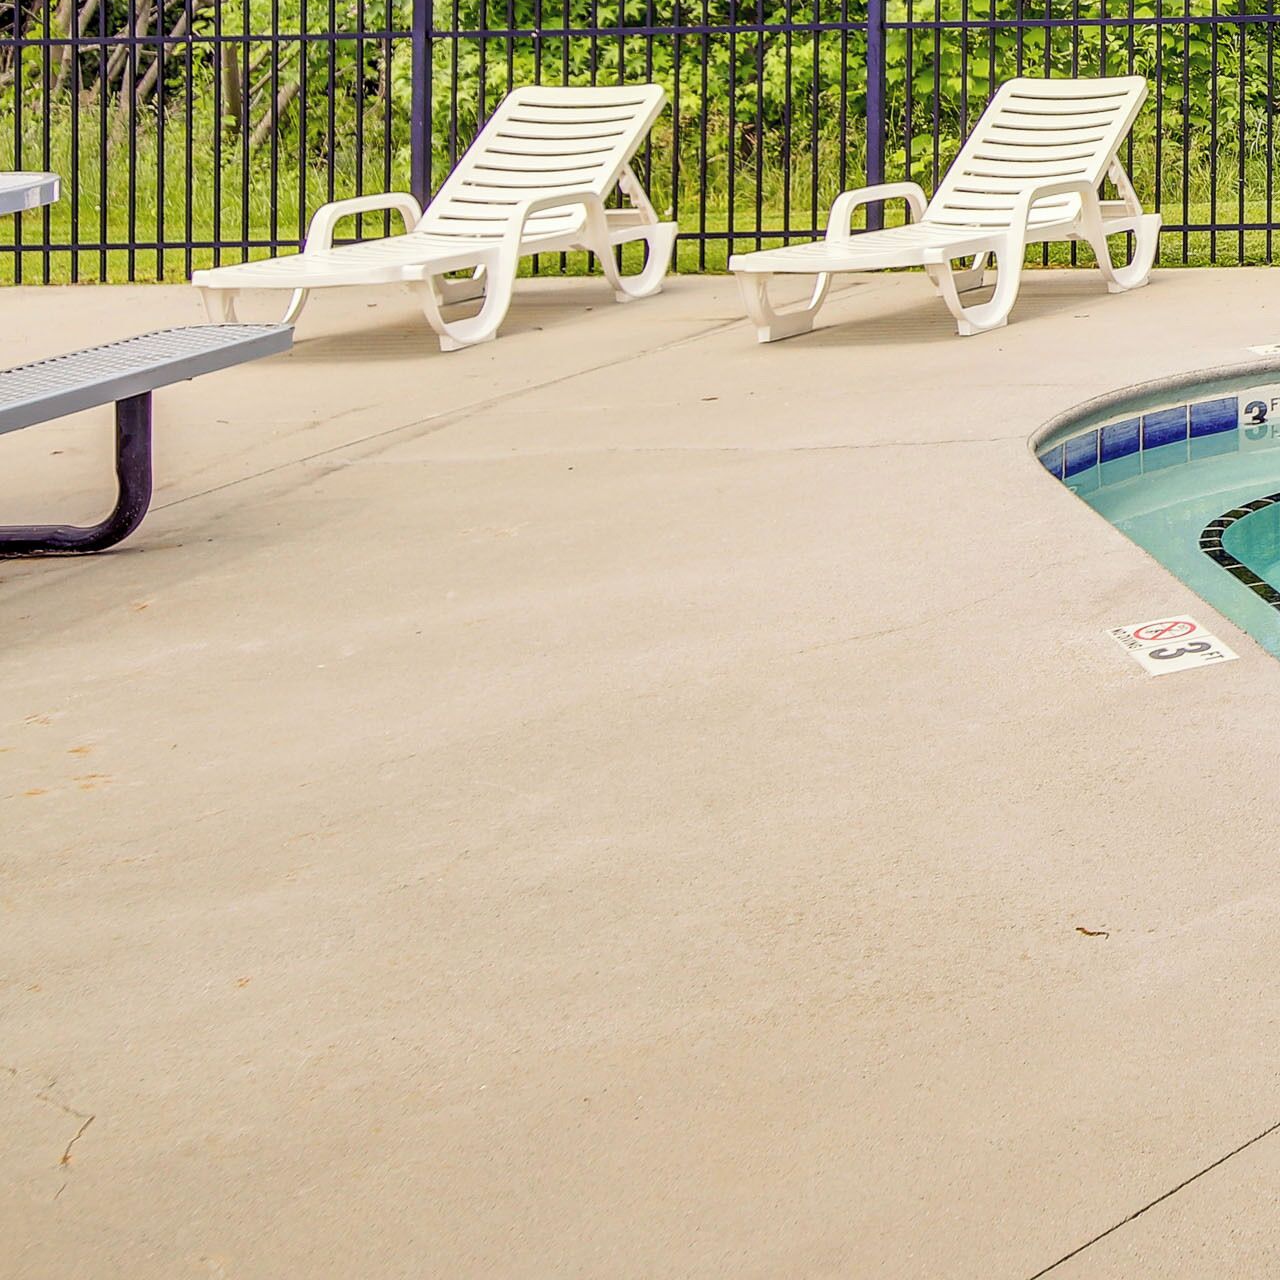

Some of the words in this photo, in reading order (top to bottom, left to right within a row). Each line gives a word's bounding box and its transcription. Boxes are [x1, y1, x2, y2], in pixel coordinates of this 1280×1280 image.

[1244, 400, 1269, 425] 3
[1149, 641, 1211, 660] 3
[1201, 650, 1224, 661] FT
